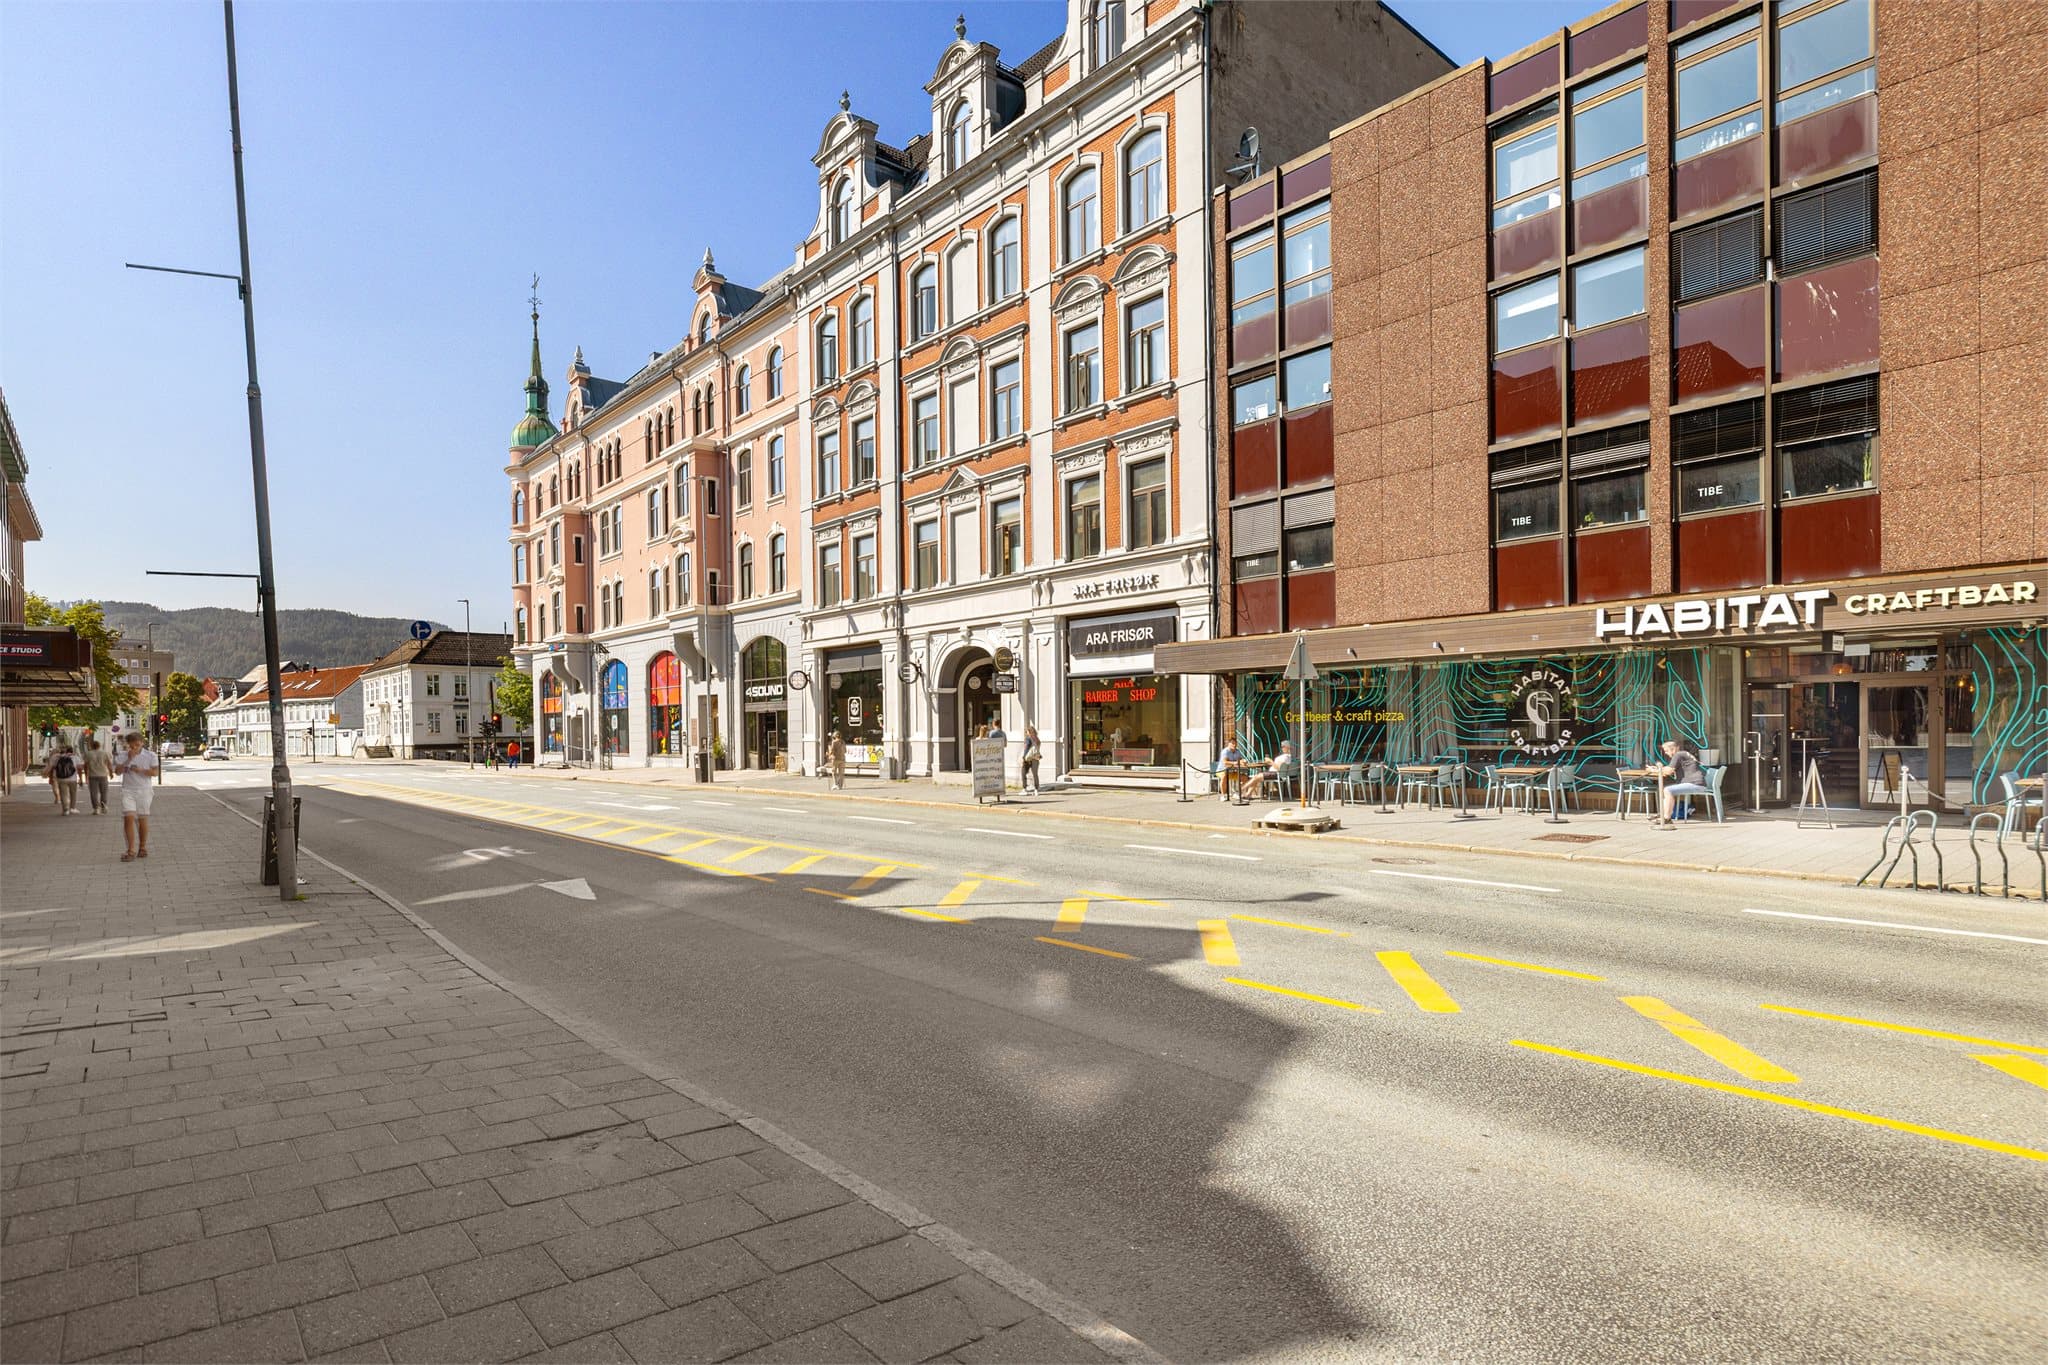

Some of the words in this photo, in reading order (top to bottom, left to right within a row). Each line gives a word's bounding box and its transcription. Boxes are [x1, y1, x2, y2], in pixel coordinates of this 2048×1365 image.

[1697, 484, 1724, 498] TIBE
[1511, 515, 1532, 527] TIBE
[1072, 582, 1098, 596] ARA
[1103, 572, 1154, 591] FRISØR
[1844, 580, 2037, 614] CRAFTBAR
[1595, 588, 1831, 638] HABITAT
[1085, 631, 1109, 646] ARA
[1110, 626, 1154, 644] FRISØR
[745, 684, 784, 698] 4SOUND
[1511, 670, 1572, 697] HABITAT
[1085, 689, 1119, 703] BARBER
[1129, 688, 1157, 702] SHOP
[1285, 711, 1332, 723] Cratbeer
[1334, 710, 1344, 722] &
[1346, 710, 1372, 722] craft
[1375, 710, 1405, 723] pizza
[1510, 729, 1573, 757] CRAFTBAR
